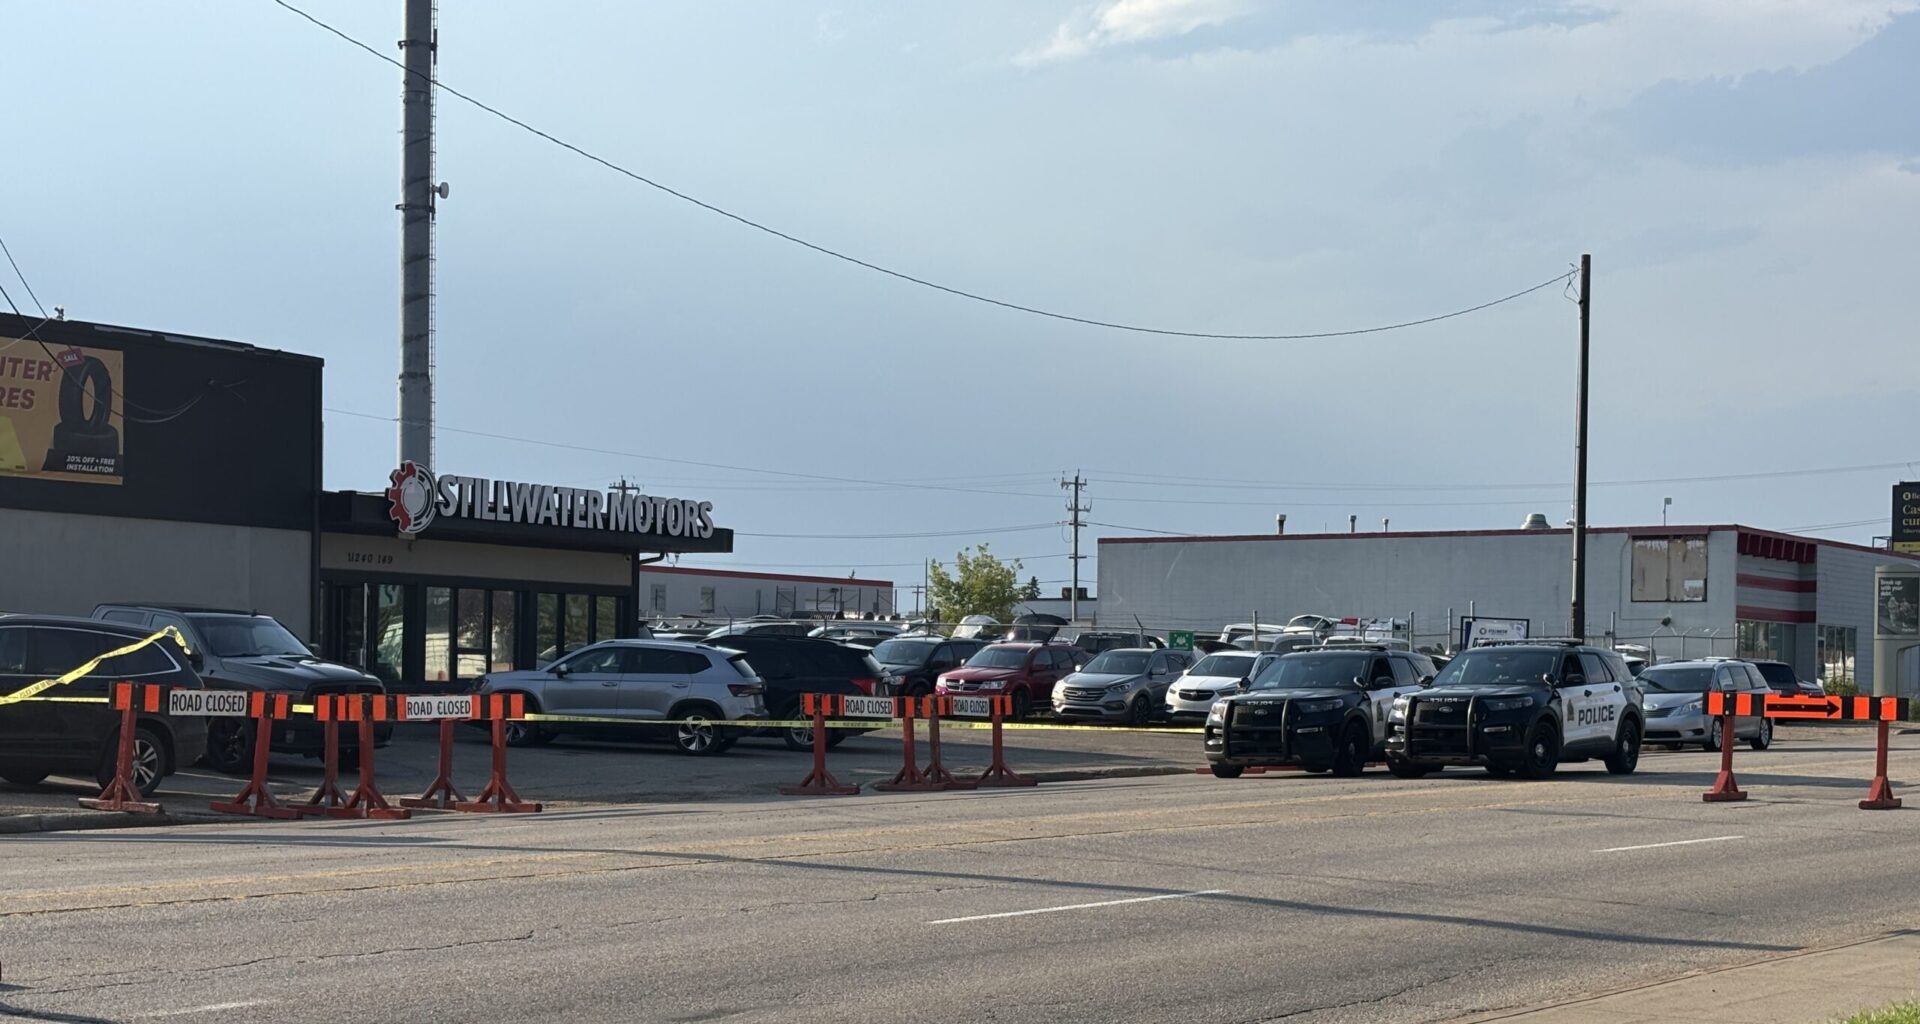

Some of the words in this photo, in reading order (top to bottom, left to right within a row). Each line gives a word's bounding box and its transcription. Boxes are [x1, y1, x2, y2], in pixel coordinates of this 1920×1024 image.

[63, 353, 78, 362] SALE
[66, 455, 81, 463] 20%
[82, 456, 95, 464] OFF
[100, 457, 115, 465] FREE
[66, 463, 114, 473] INSTALLATION
[437, 474, 604, 529] STILLWATER
[607, 492, 714, 539] MOTORS
[171, 694, 202, 712] ROAD
[205, 694, 245, 712] CLOSED
[407, 700, 433, 716] ROAD
[437, 700, 471, 715] CLOSED
[845, 699, 865, 714] ROAD
[867, 699, 893, 715] CLOSED
[954, 698, 968, 713] ROAD
[969, 699, 989, 714] CLOSED
[1578, 704, 1615, 727] POLICE
